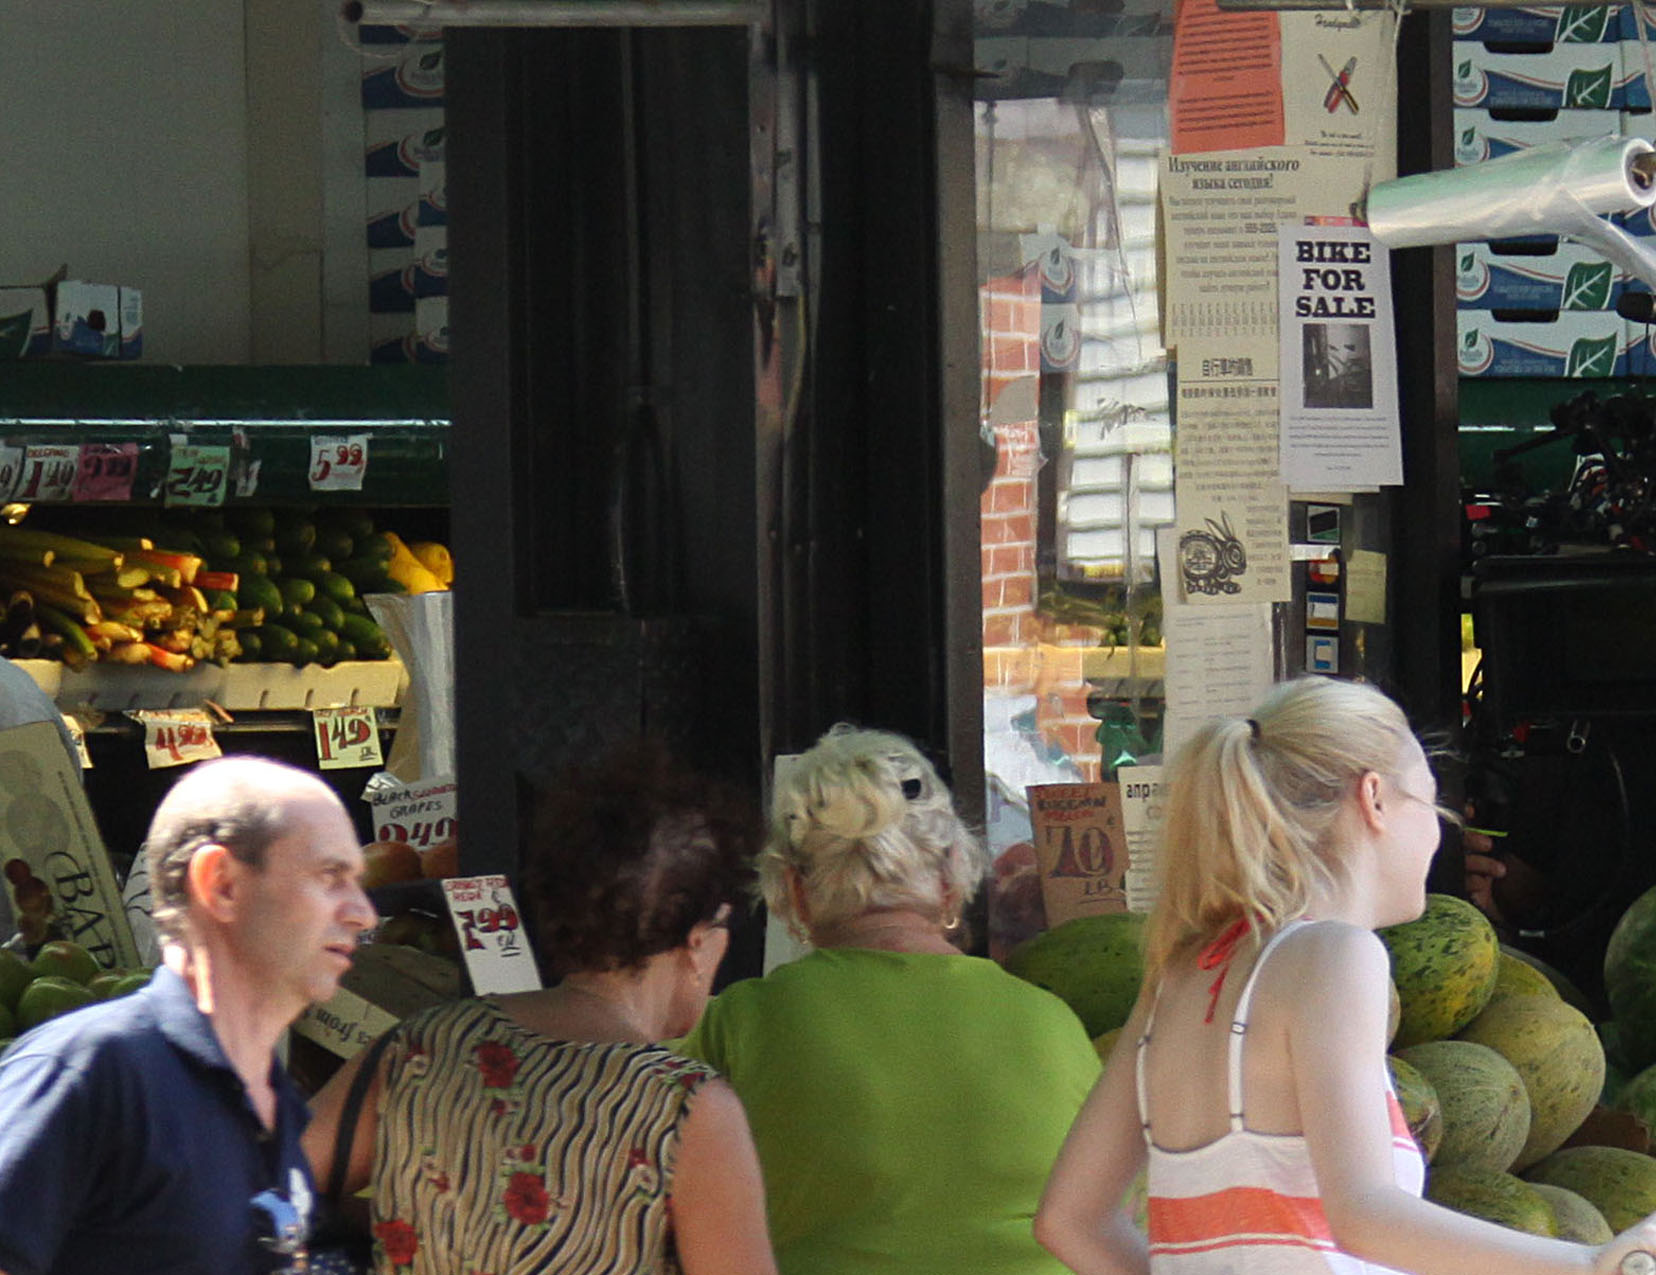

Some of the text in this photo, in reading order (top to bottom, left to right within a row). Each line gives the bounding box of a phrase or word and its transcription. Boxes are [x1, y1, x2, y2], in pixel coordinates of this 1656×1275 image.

[1296, 241, 1371, 263] BIKE
[1303, 268, 1365, 290] FOR
[1296, 296, 1375, 318] SALE
[390, 801, 442, 819] GRAPES
